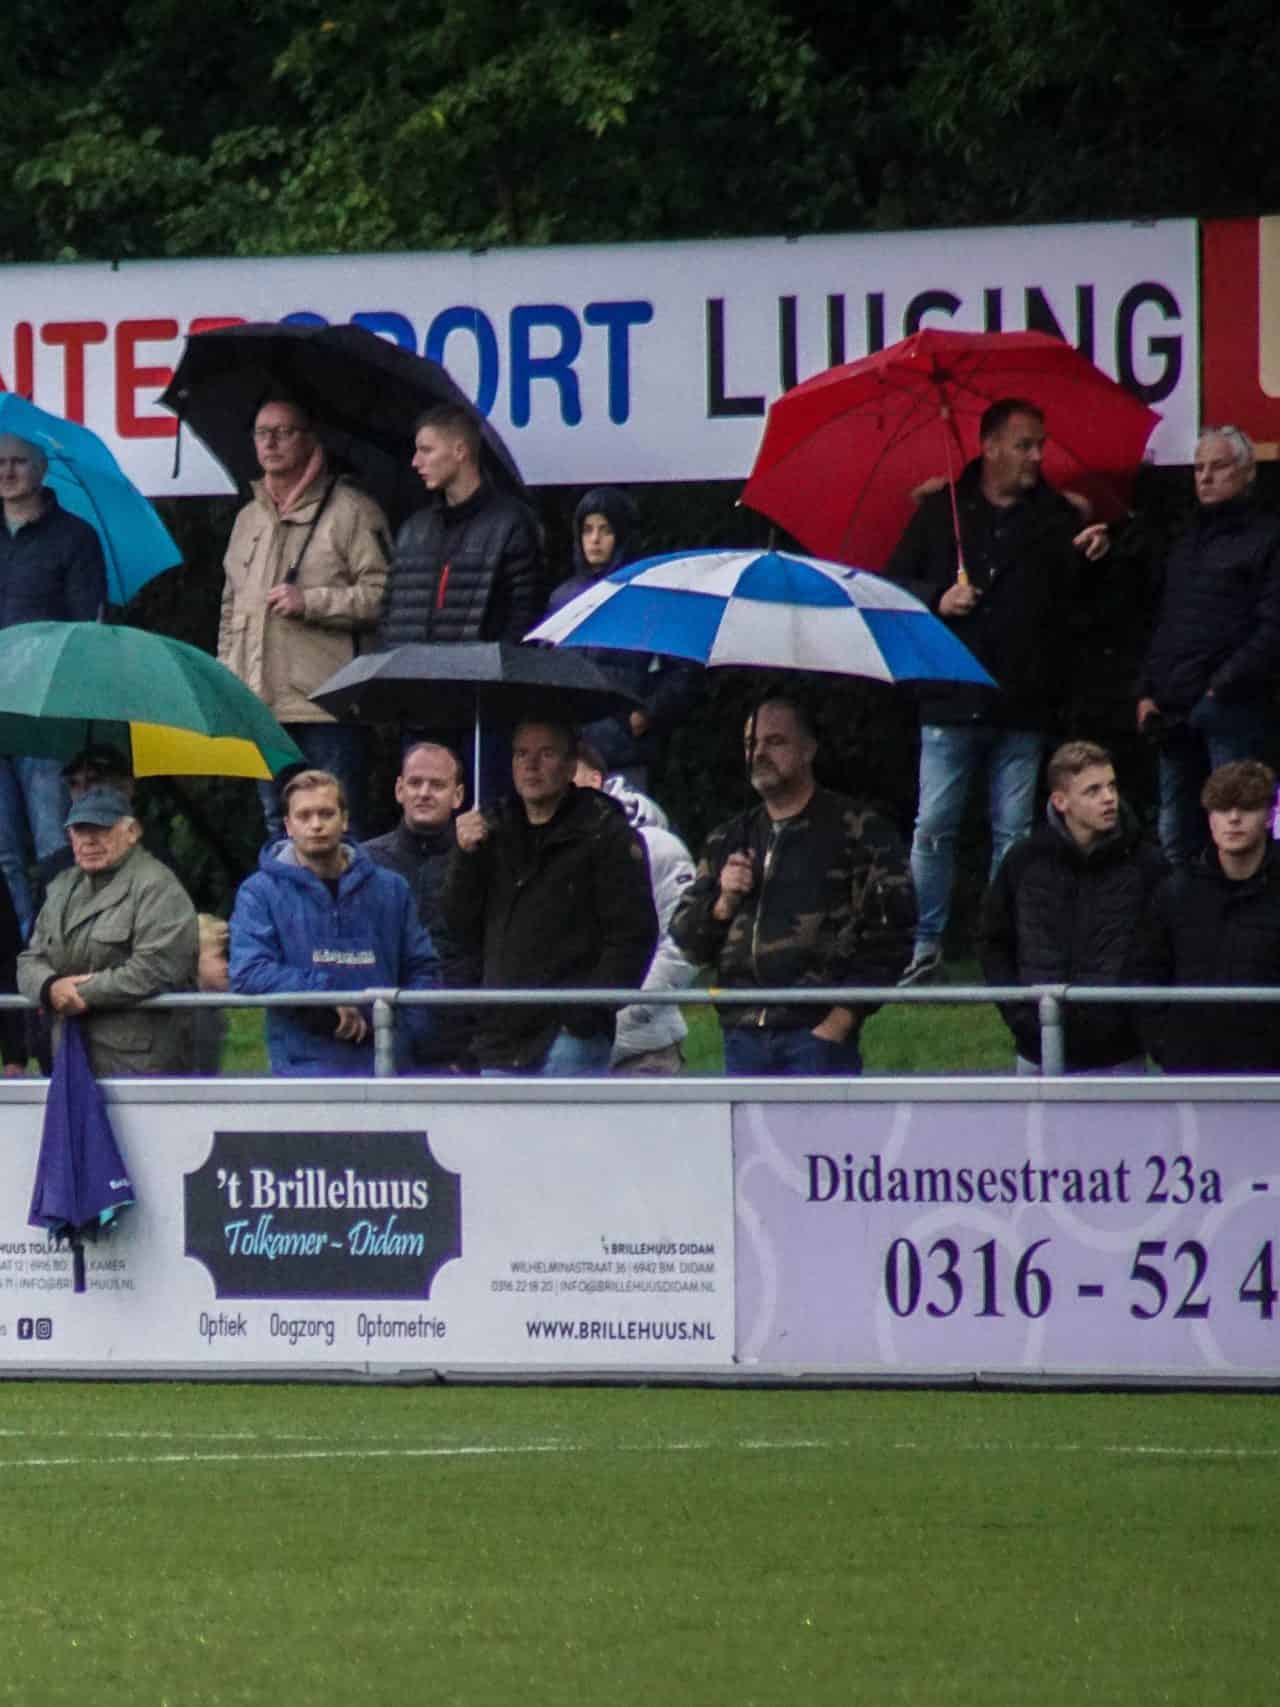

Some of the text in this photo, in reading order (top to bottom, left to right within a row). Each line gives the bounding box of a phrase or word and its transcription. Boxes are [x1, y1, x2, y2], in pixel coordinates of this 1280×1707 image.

[217, 1168, 430, 1210] 't Brillehuus
[805, 1153, 1132, 1203] Didamsestraat
[1144, 1154, 1224, 1203] 23a
[224, 1214, 328, 1260] Tolkamer
[347, 1214, 425, 1257] Didam
[611, 1242, 677, 1256] BRILLEHUUS
[679, 1242, 715, 1255] DIDAM
[679, 1261, 715, 1273] DIDAM
[885, 1237, 1053, 1318] 0316
[1130, 1240, 1212, 1319] 52
[199, 1313, 446, 1346] Optiek Oogzorg Optometrie
[525, 1321, 715, 1340] WWW.BRILLEHUUS.NL
